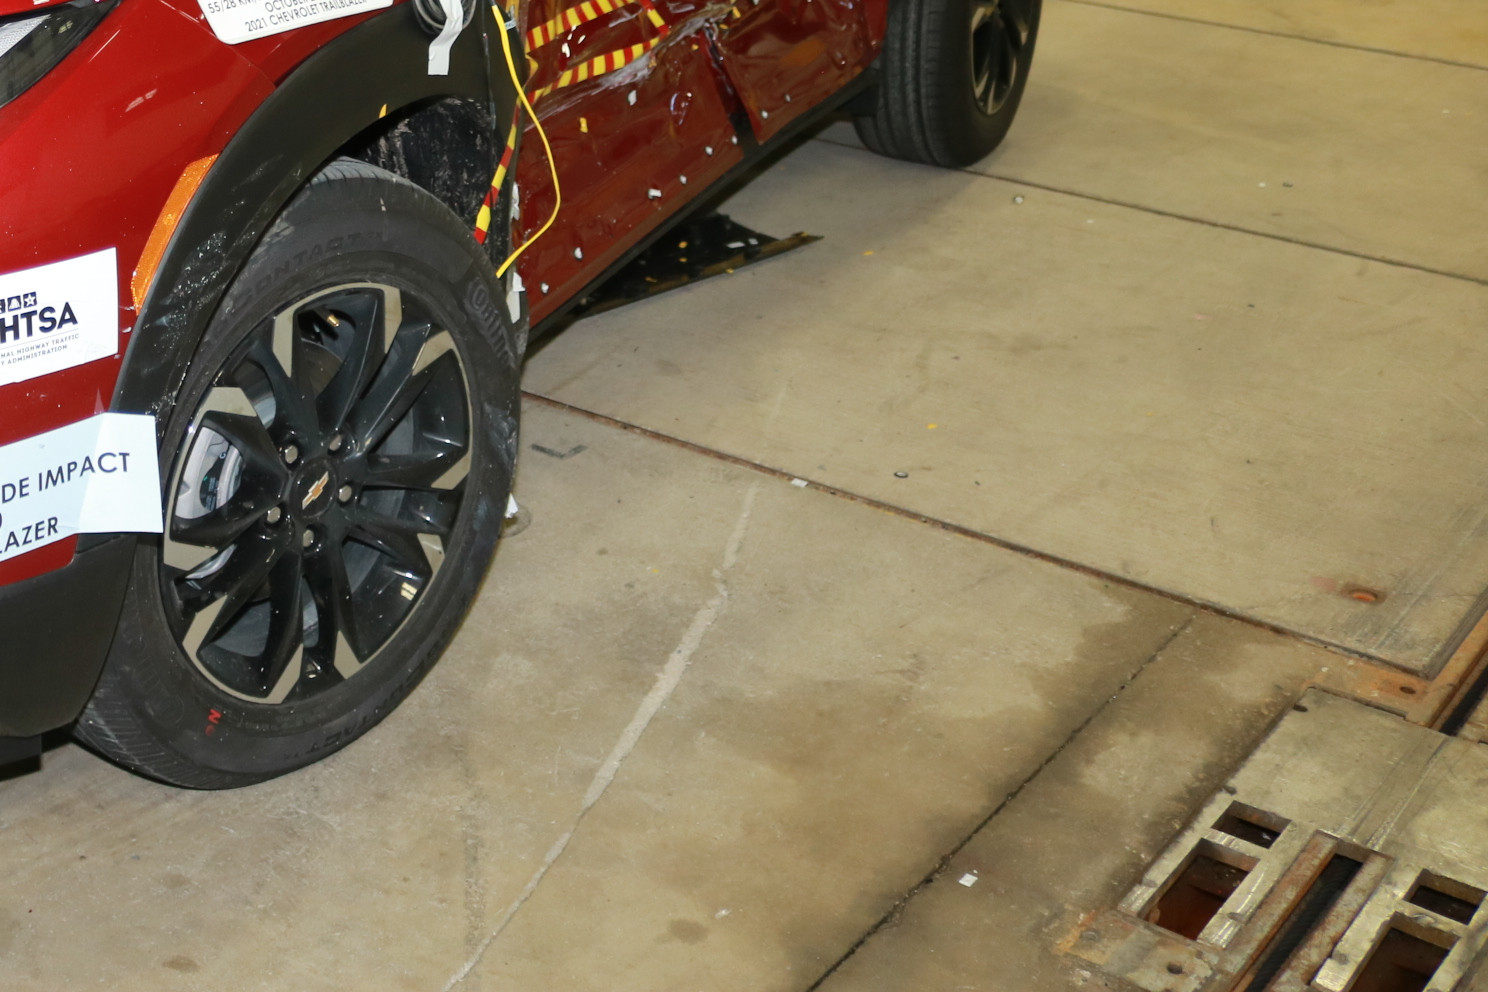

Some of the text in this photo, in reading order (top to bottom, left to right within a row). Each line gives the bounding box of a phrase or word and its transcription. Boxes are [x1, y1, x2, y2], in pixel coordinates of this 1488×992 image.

[245, 17, 268, 32] 2021
[269, 5, 321, 26] CHEVROLET
[7, 344, 68, 366] ADMINISTRATION
[16, 342, 50, 355] HIGHWAY
[51, 332, 80, 346] TRAFFIC
[38, 452, 130, 493] IMPACT
